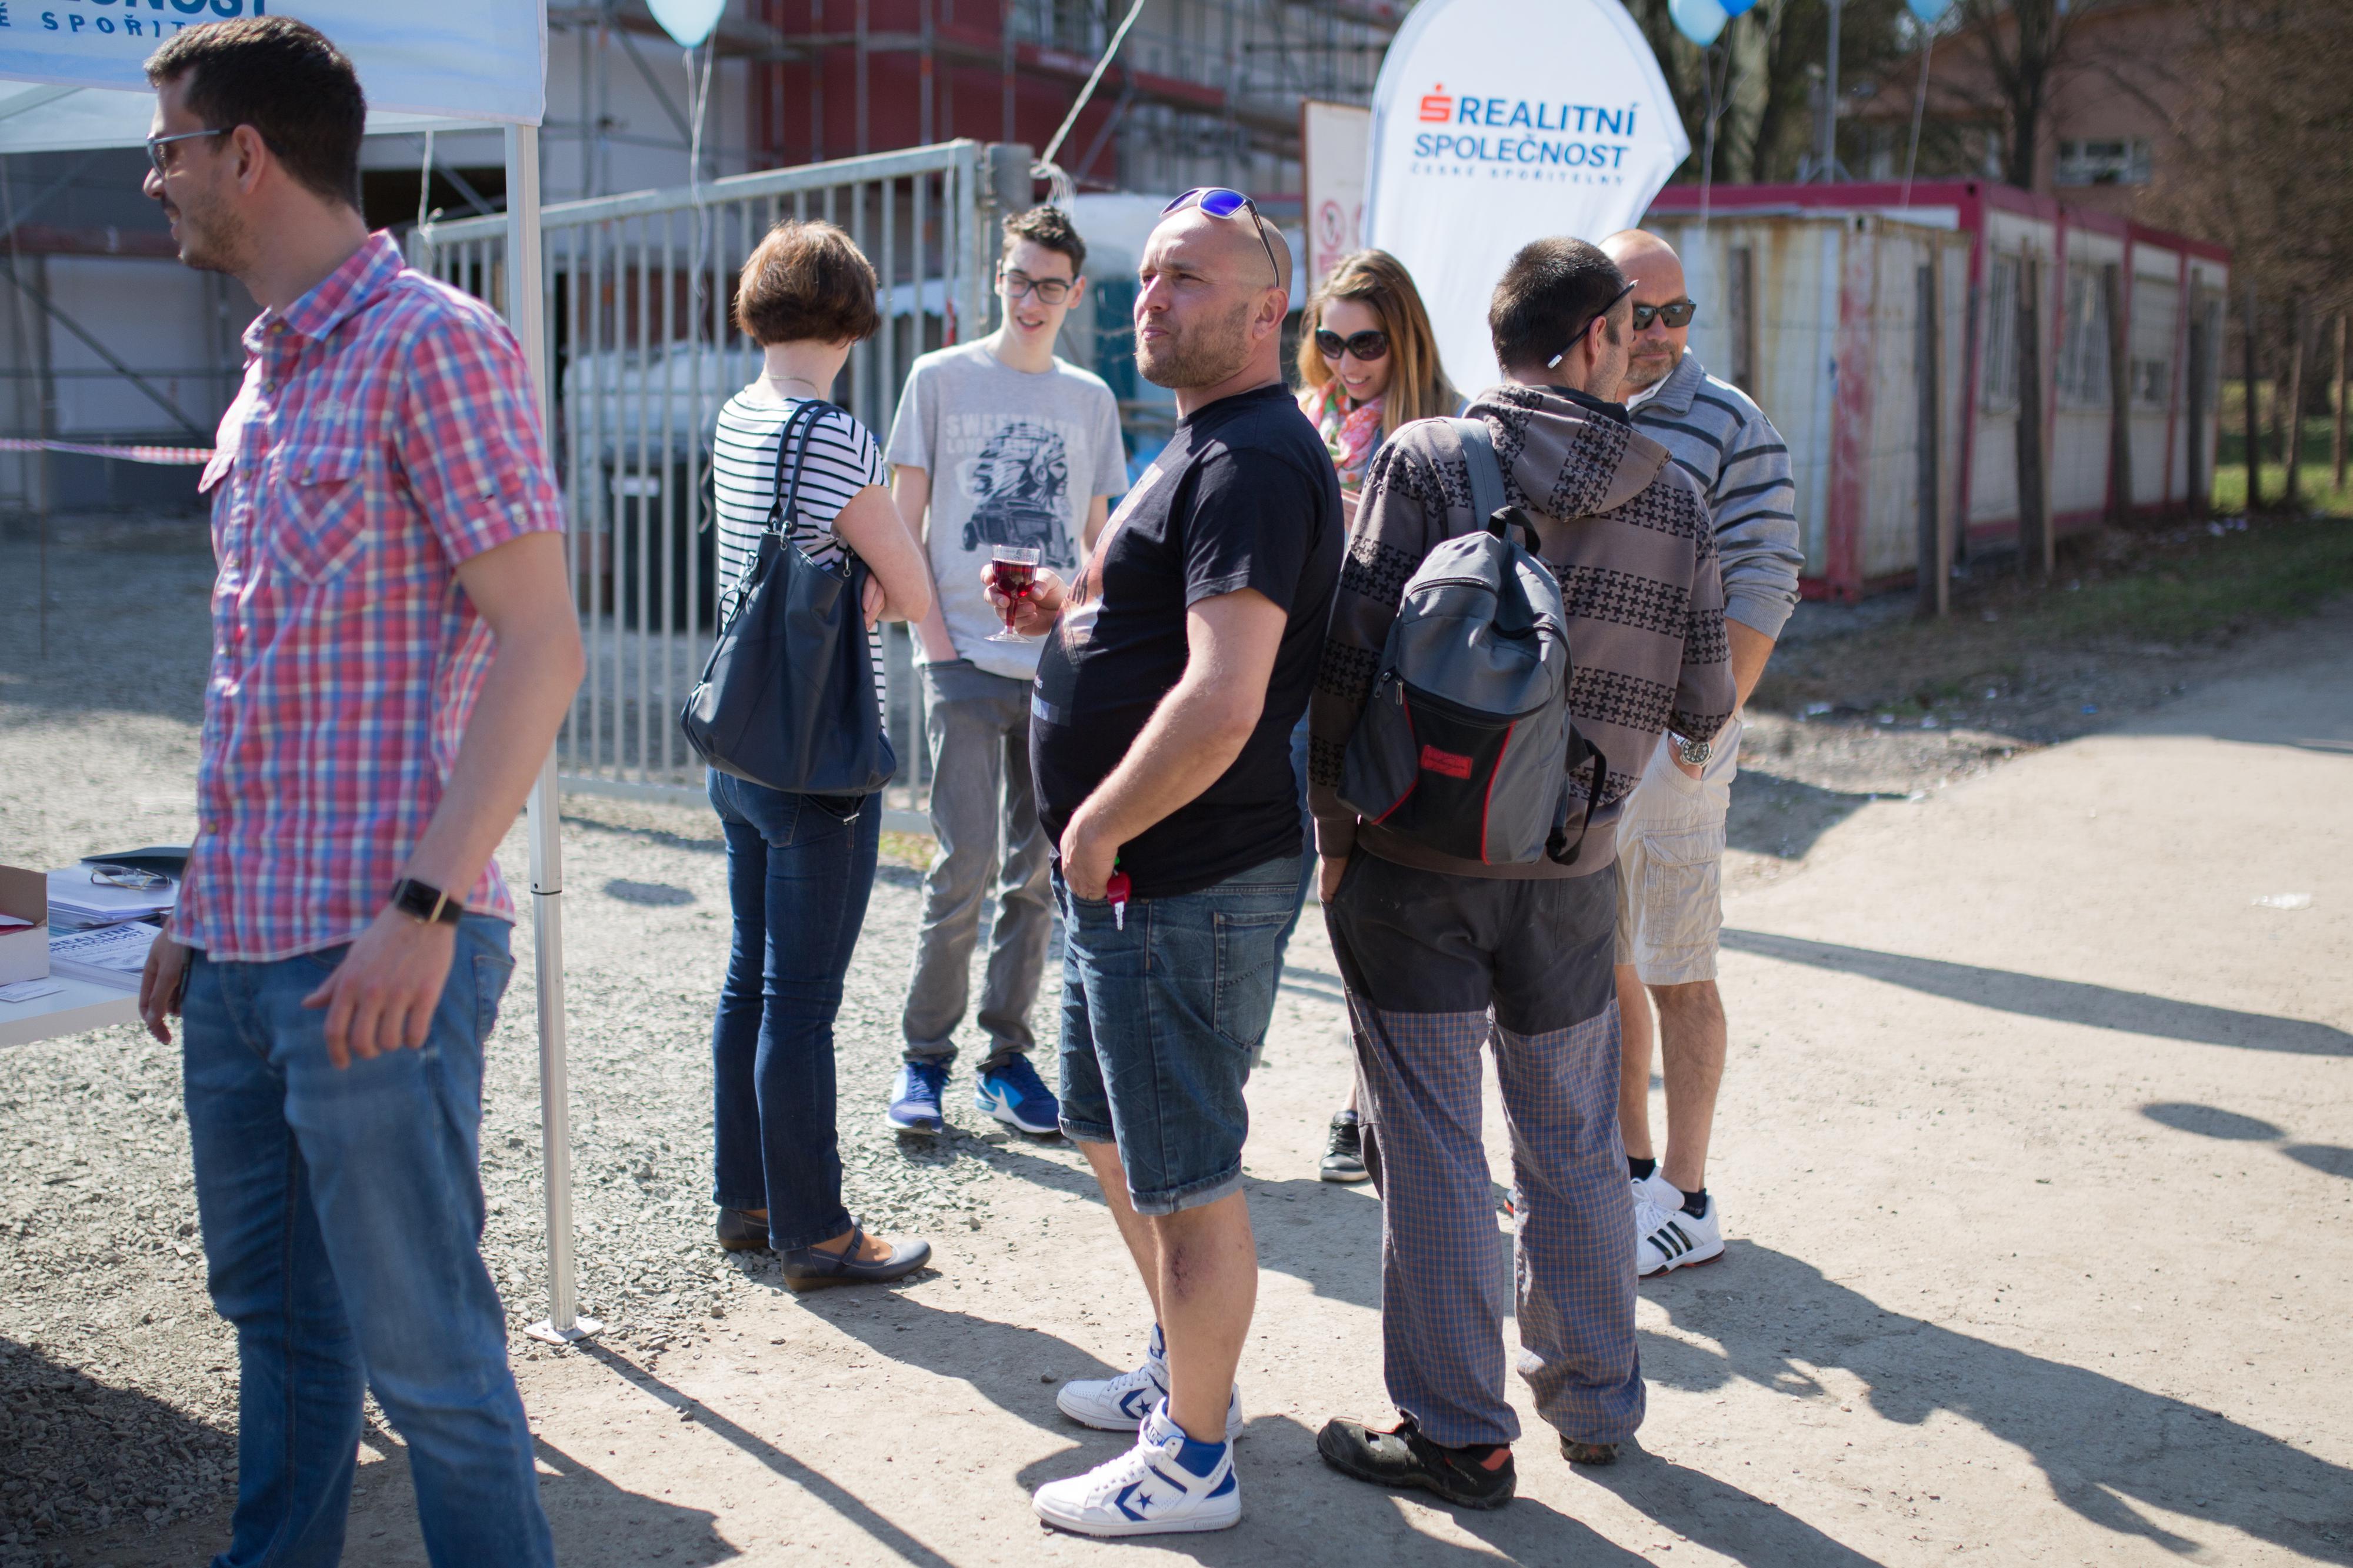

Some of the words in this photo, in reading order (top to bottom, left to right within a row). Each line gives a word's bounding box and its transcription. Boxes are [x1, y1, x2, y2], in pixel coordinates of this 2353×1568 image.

[41, 11, 186, 38] SPOŘIT
[1458, 96, 1641, 136] REALITNÍ
[1414, 133, 1629, 169] SPOLEČNOST
